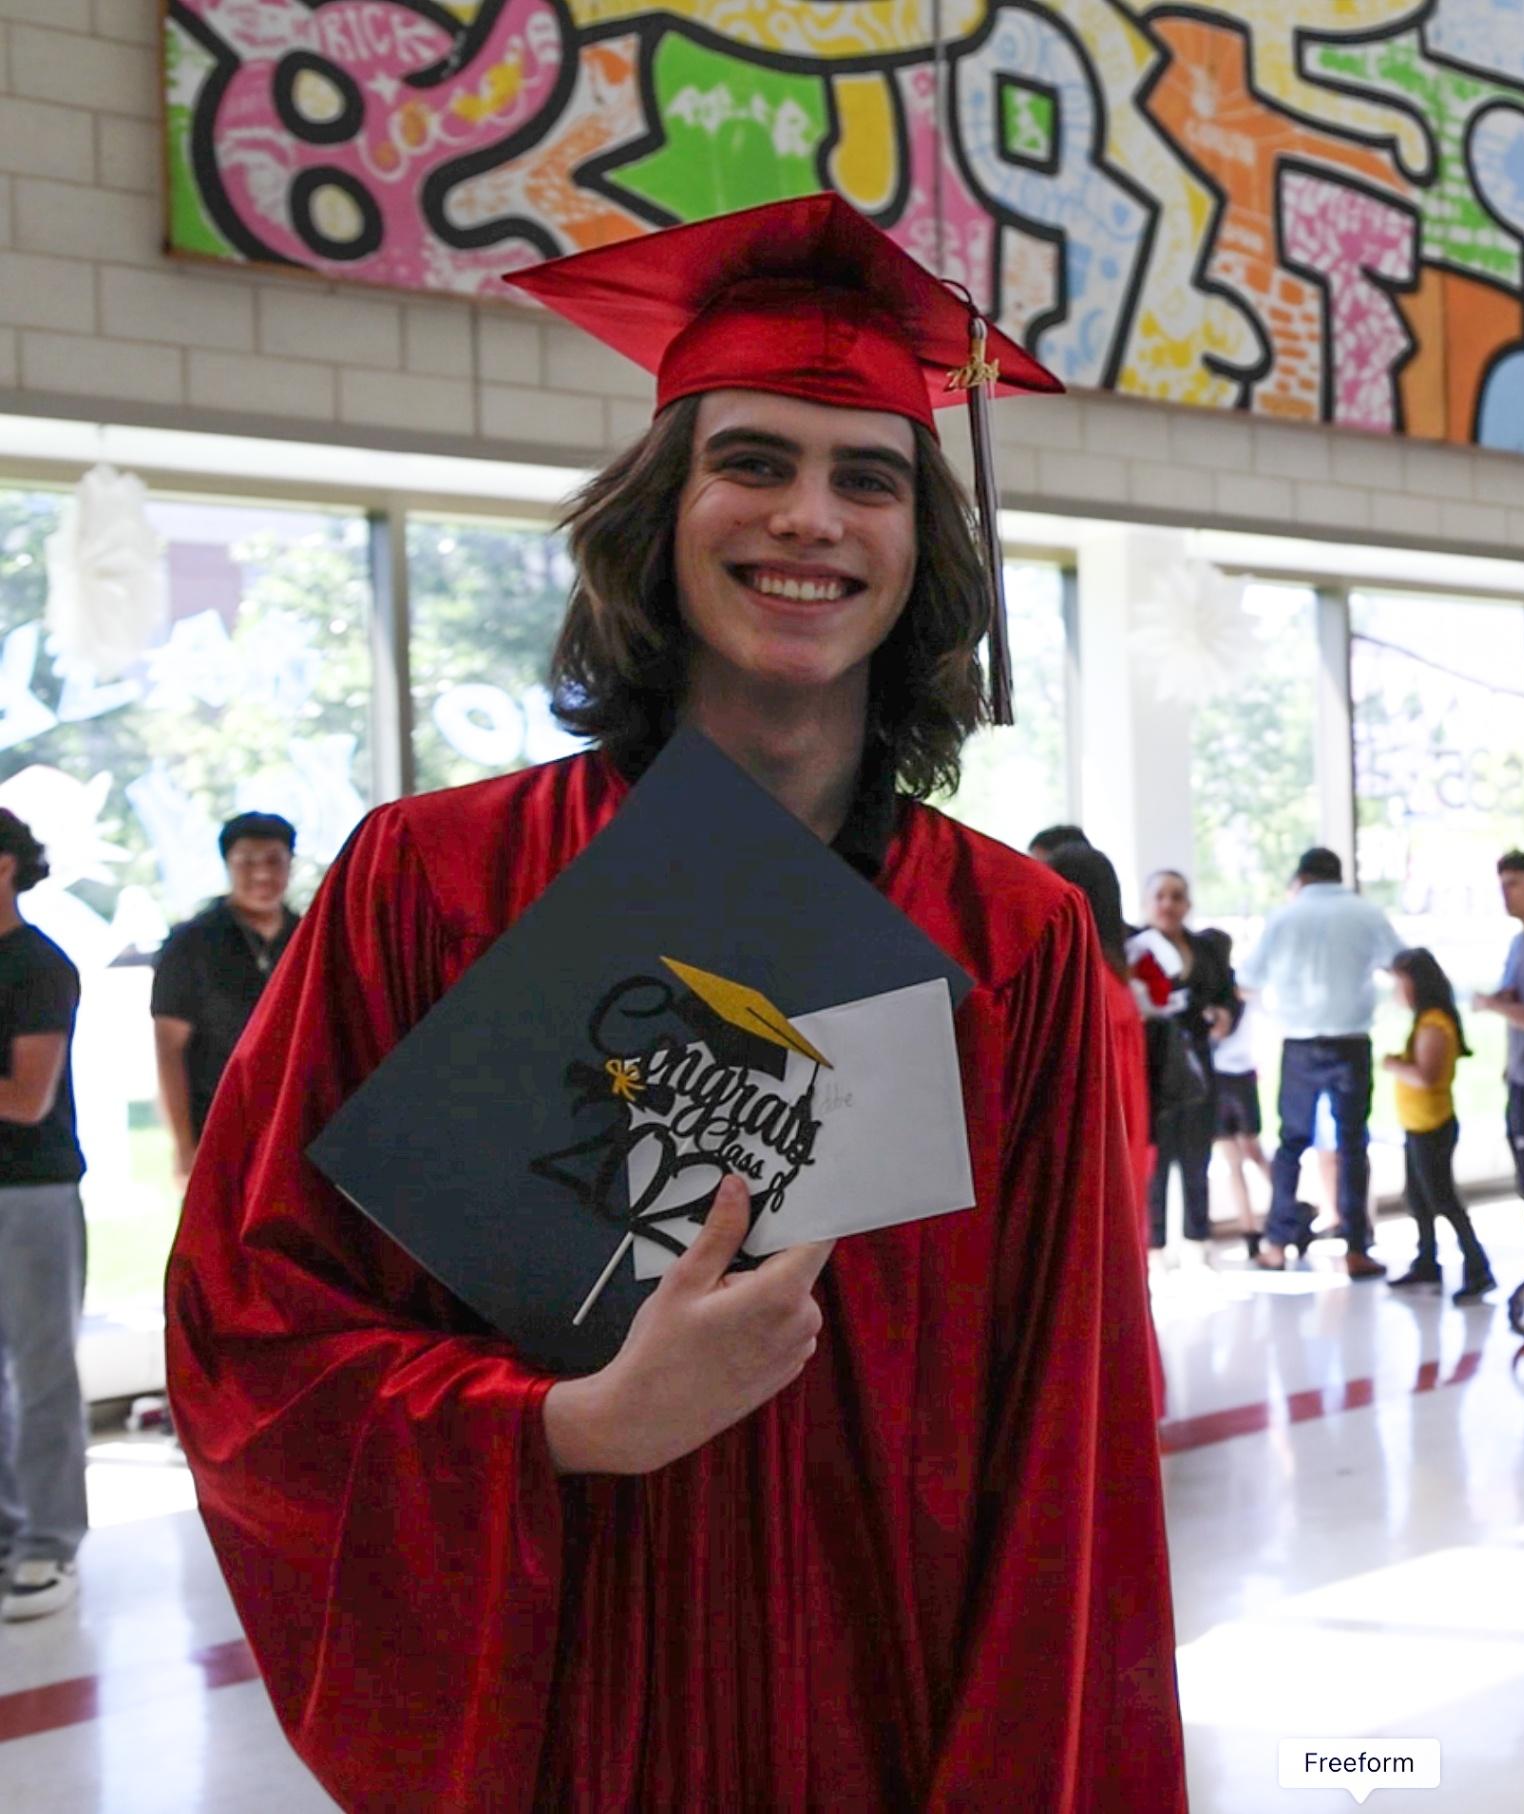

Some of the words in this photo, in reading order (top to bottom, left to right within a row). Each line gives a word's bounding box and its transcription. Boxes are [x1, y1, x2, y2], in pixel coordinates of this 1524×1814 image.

[588, 974, 822, 1166] Congrats
[694, 1116, 766, 1181] Class
[769, 1160, 804, 1213] of
